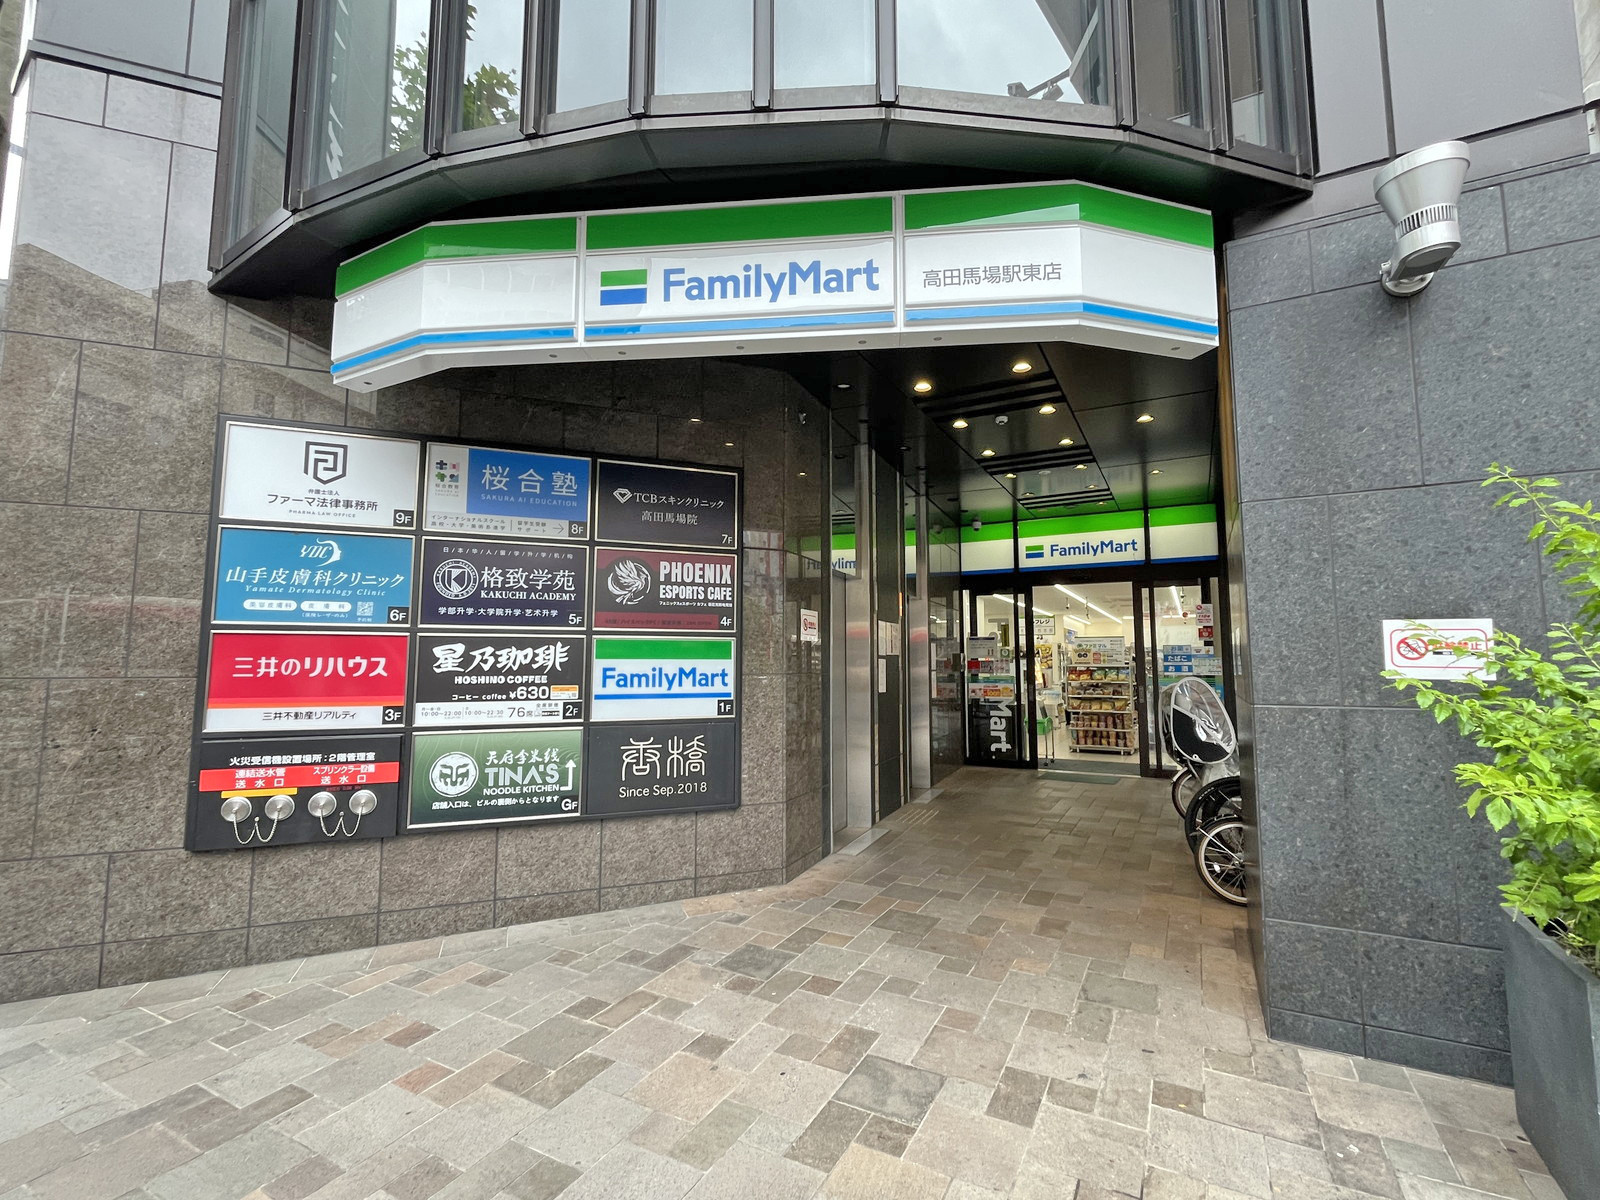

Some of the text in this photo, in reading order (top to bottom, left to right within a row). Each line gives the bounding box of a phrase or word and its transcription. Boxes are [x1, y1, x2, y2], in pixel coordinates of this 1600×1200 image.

[663, 259, 879, 302] FamilyMart
[922, 262, 1062, 288] 高田馬場駅東店
[481, 464, 578, 497] 桜合塾
[308, 488, 340, 496] 弁護士法人
[267, 494, 378, 511] ファーマ法律事務所
[481, 493, 514, 502] SAKURA
[530, 497, 578, 507] EDUCATION
[634, 492, 724, 509] TCBスキンクリニック
[395, 512, 412, 524] 9F
[641, 510, 698, 525] 高田馬場院
[571, 524, 584, 534] 8F
[722, 534, 732, 544] 7F
[1050, 539, 1138, 557] FamilyMart
[225, 566, 405, 588] 山手皮膚科クリニック
[480, 566, 576, 591] 格致学苑
[660, 561, 732, 584] PHOENIX
[245, 585, 386, 596] Yamate Dermatology Clinic
[480, 590, 526, 600] KAKUCHI
[529, 591, 576, 602] ACADEMY
[660, 584, 732, 600] ESPORTS CAFE
[390, 610, 406, 622] 6F
[568, 614, 582, 625] 5F
[720, 616, 732, 626] 4F
[432, 641, 570, 674] 星乃珈琲
[232, 656, 388, 678] 三井のリハウス
[454, 675, 548, 684] HOSHINO COFFEE
[602, 666, 728, 691] FamilyMart
[509, 686, 550, 700] ¥630
[566, 706, 578, 716] 2F
[719, 702, 732, 712] 1F
[262, 711, 357, 720] 三井不動産リアルティ
[384, 710, 402, 721] 3F
[236, 768, 286, 779] 連結送水管
[320, 775, 366, 784] 送水口
[484, 764, 560, 786] TINA'S
[236, 778, 284, 788] 送水口
[483, 784, 560, 796] NOODLE KITCHEN
[619, 782, 707, 798] Since Sep.2018
[561, 798, 578, 810] GF
